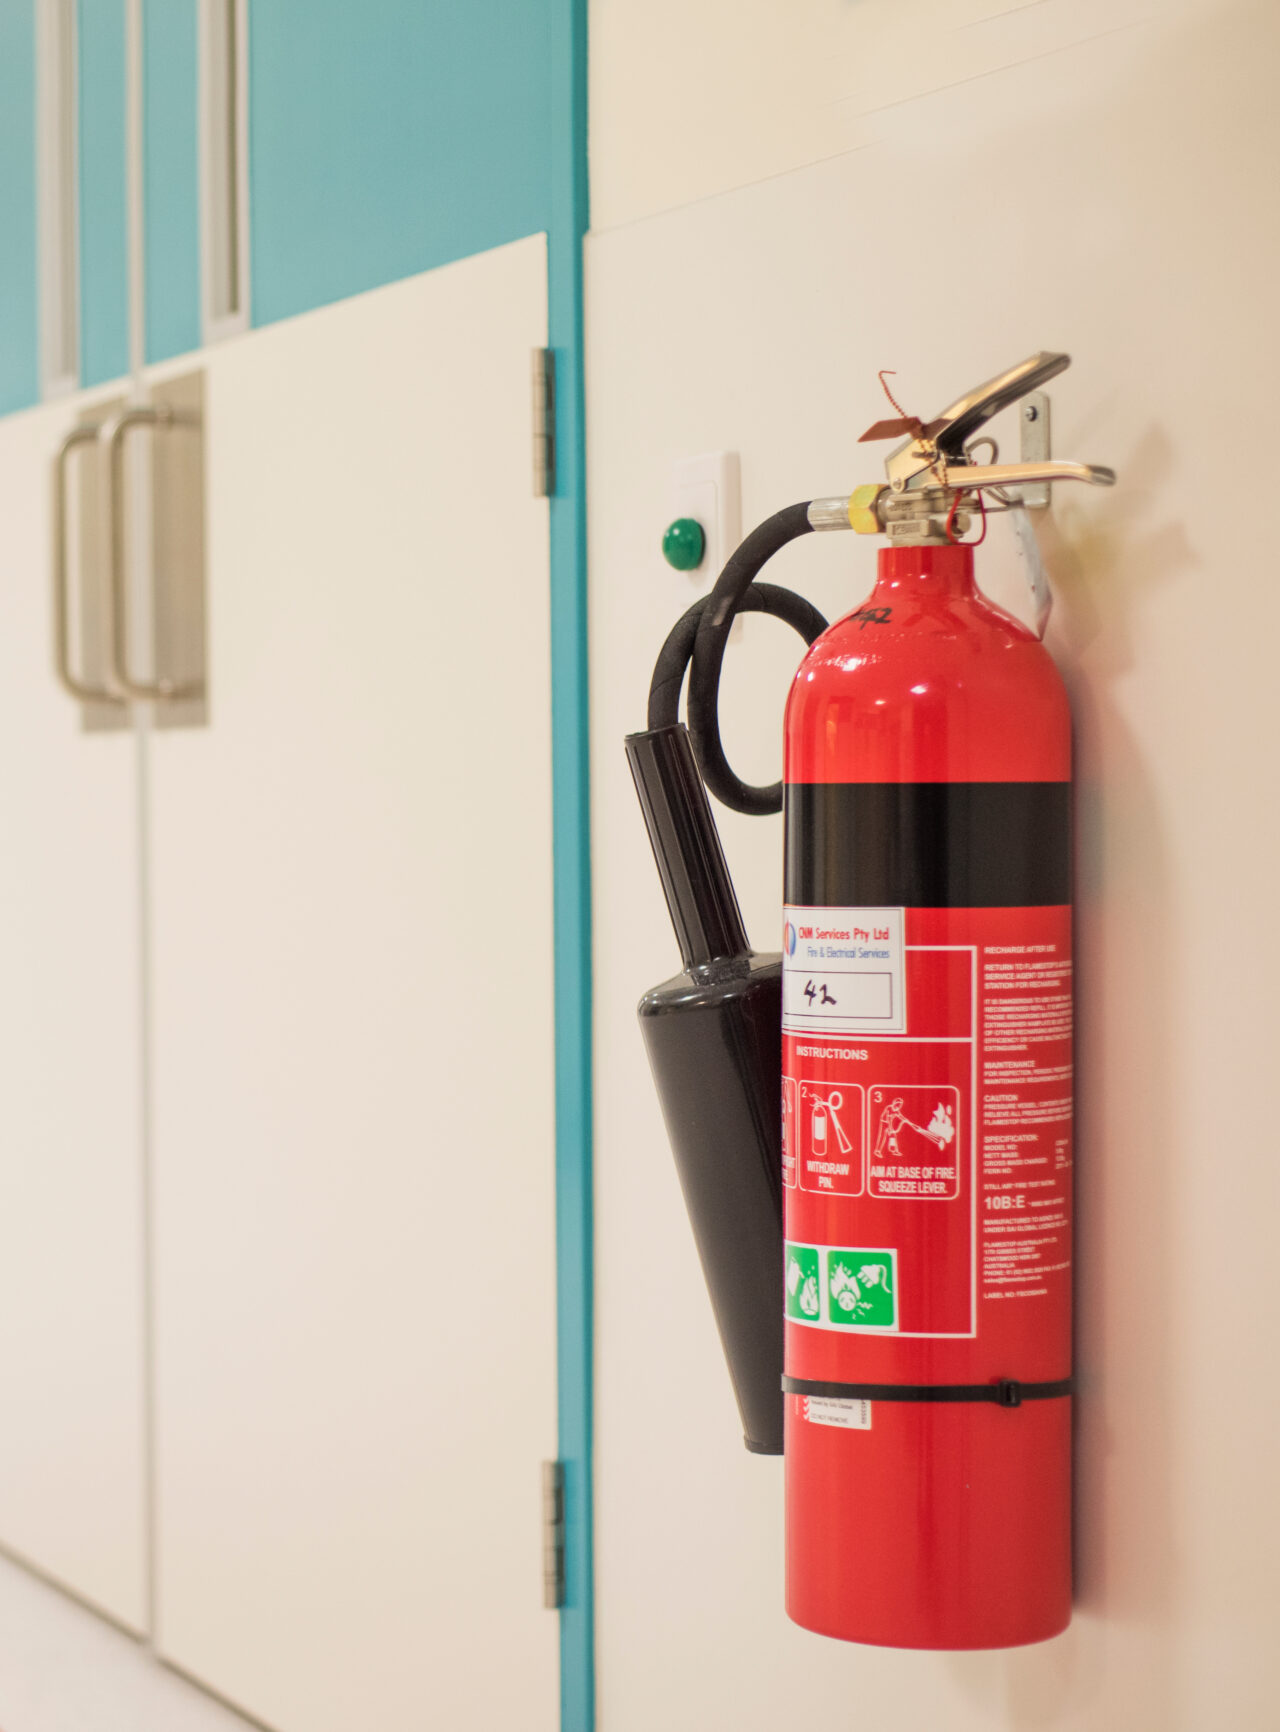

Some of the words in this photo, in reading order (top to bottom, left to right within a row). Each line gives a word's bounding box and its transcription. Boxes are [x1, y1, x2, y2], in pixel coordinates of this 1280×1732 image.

[816, 927, 851, 940] Services
[853, 927, 869, 943] Pty
[873, 927, 890, 940] Ltd
[858, 946, 890, 958] Services
[803, 979, 837, 1007] 42
[796, 1045, 869, 1061] INSTRUCTIONS
[801, 1086, 807, 1098] 2
[874, 1091, 883, 1103] 3
[806, 1160, 850, 1176] WITHDRAW
[870, 1165, 885, 1178] AIM
[886, 1166, 897, 1178] AT
[898, 1166, 921, 1179] BASE
[922, 1167, 934, 1179] OF
[818, 1176, 834, 1189] PIN.
[878, 1180, 917, 1193] SQUEEZE
[918, 1181, 948, 1194] LEVER.
[984, 1195, 1026, 1210] 10B:E
